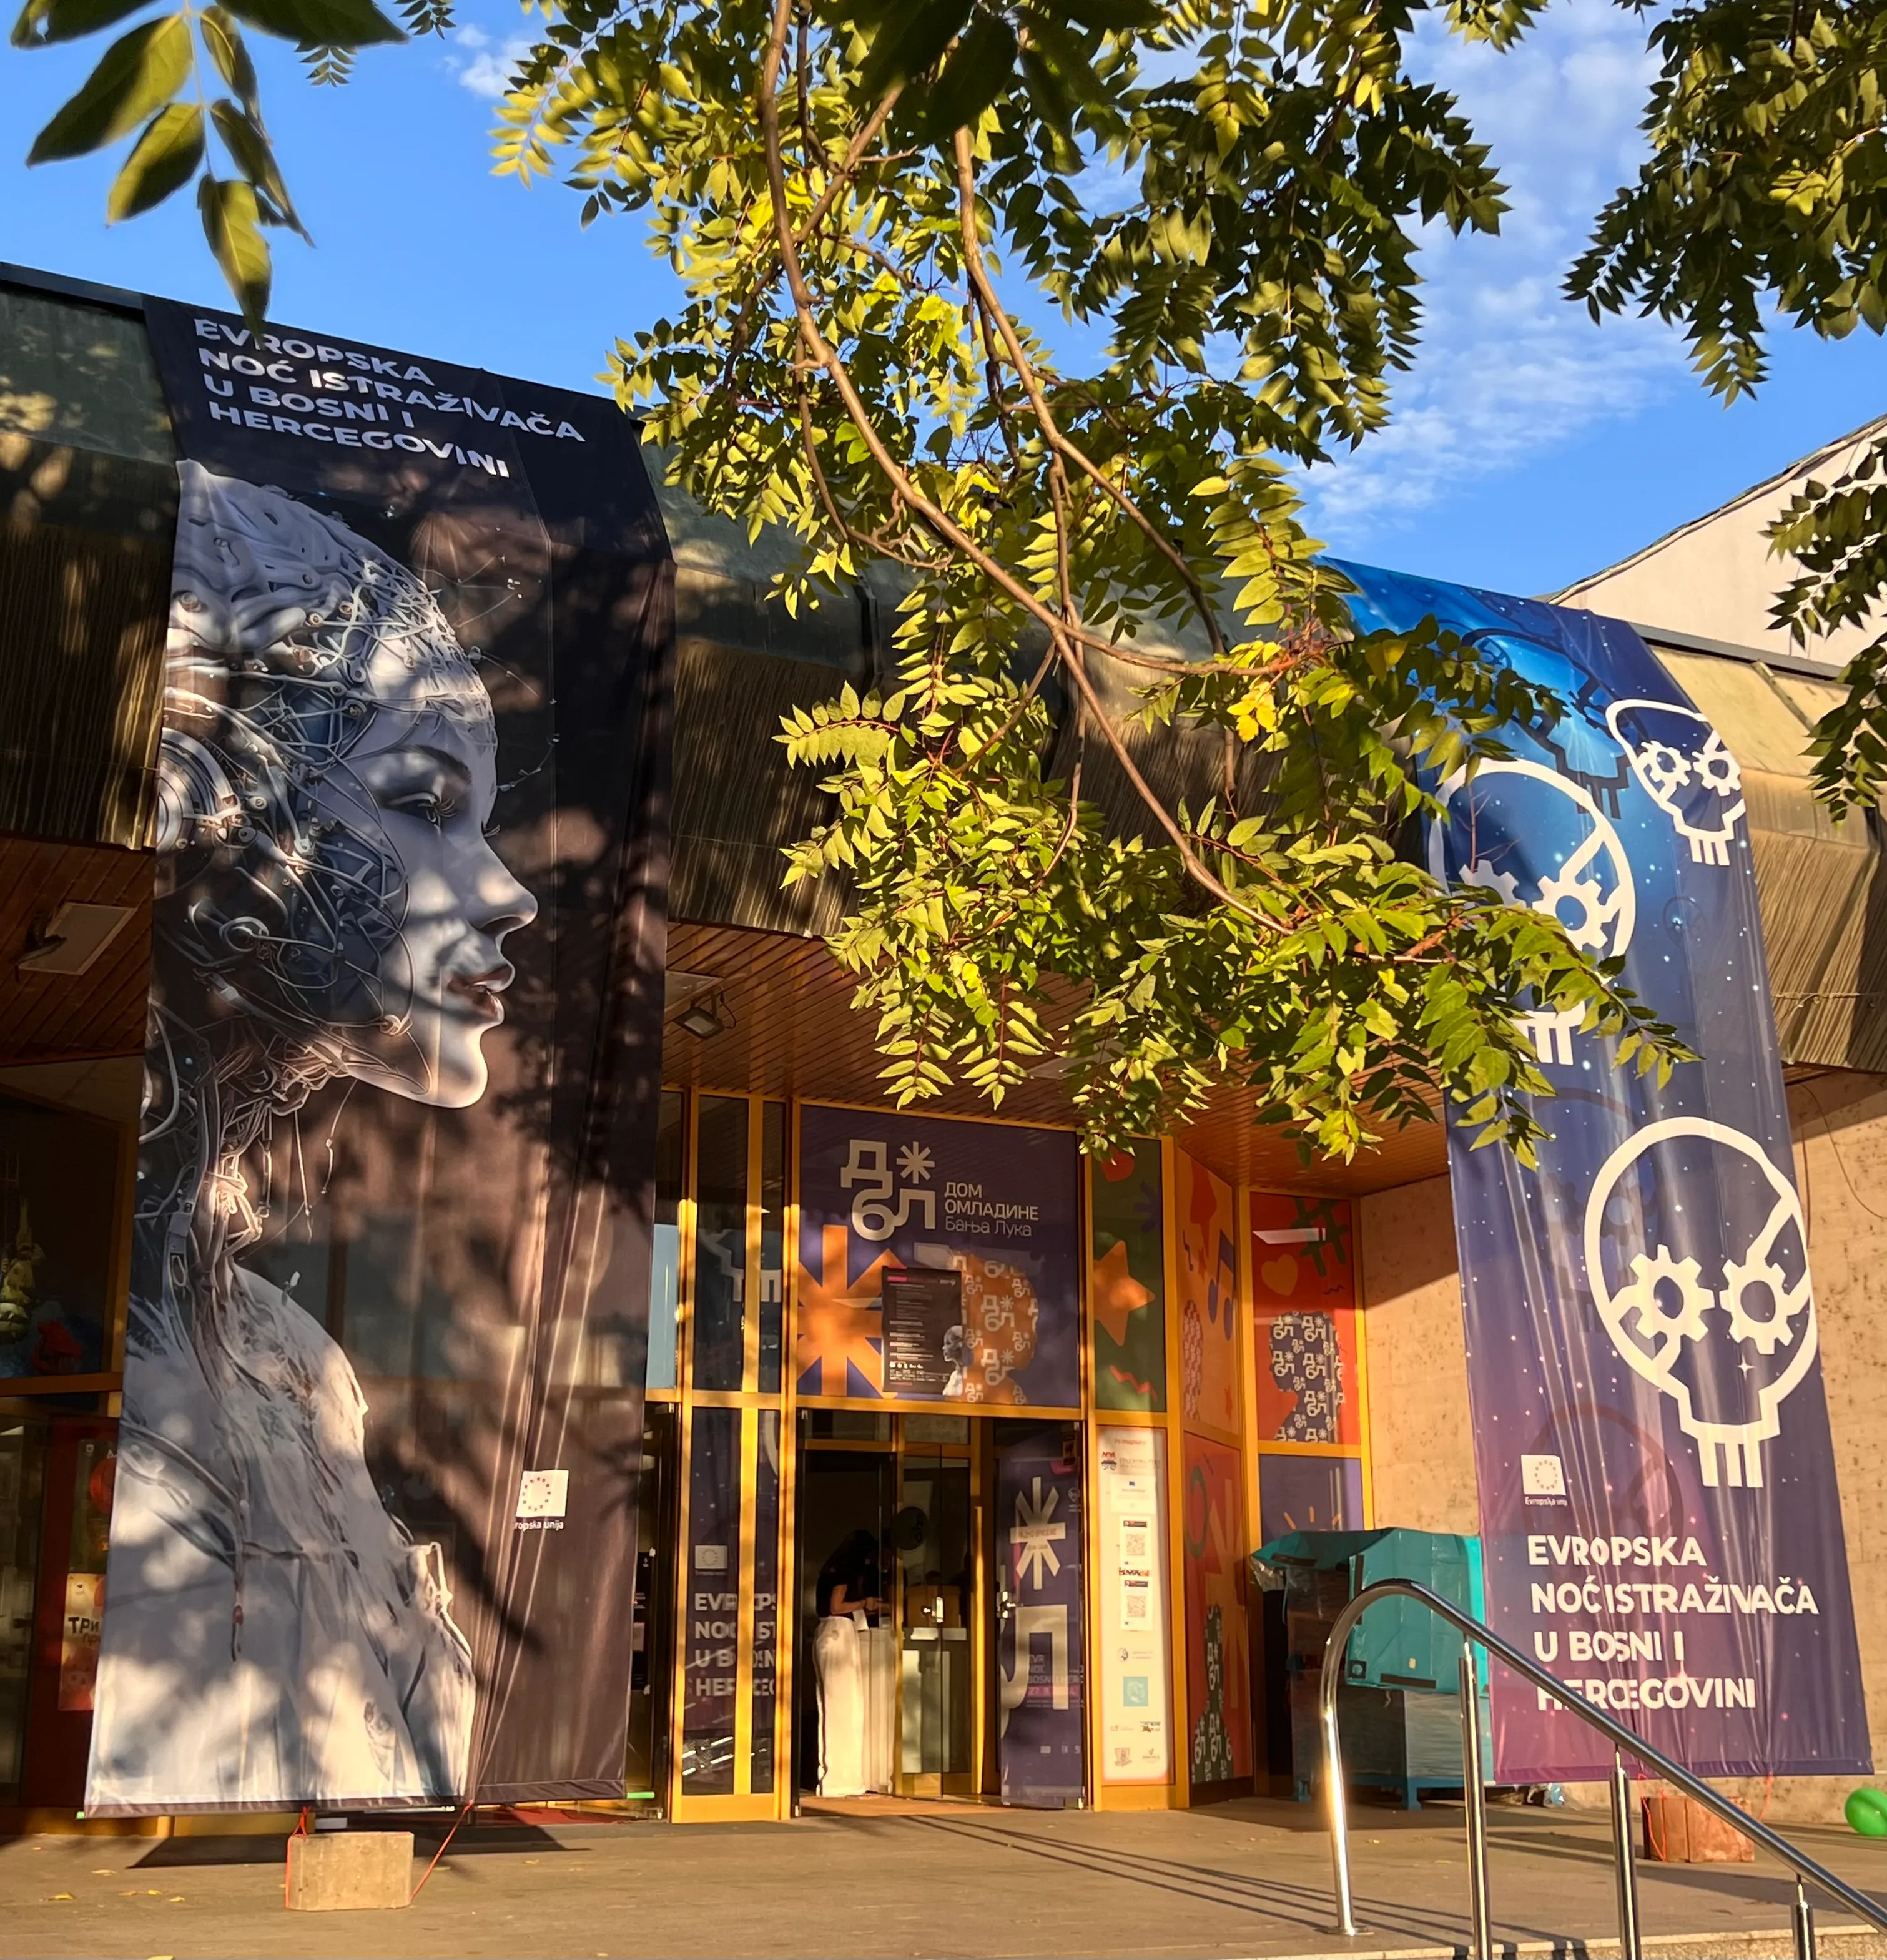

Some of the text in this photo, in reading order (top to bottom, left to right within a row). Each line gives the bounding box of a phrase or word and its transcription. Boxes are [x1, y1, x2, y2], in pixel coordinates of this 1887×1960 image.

[193, 318, 435, 386] EVROPSKA
[198, 347, 586, 442] NOĆ ISTRAŽIVAČA
[203, 373, 415, 428] U BOSNI I
[209, 401, 510, 478] HERCEGOVINI
[944, 1181, 982, 1198] ДОМ
[945, 1199, 1039, 1221] ОМЛАДИНЕ
[945, 1216, 1032, 1238] Бања Лука
[1527, 1535, 1707, 1567] EVROPSKA
[1531, 1575, 1820, 1616] NOĆ ISTRAŽIVAČA
[1534, 1630, 1685, 1663] U BOSNI I
